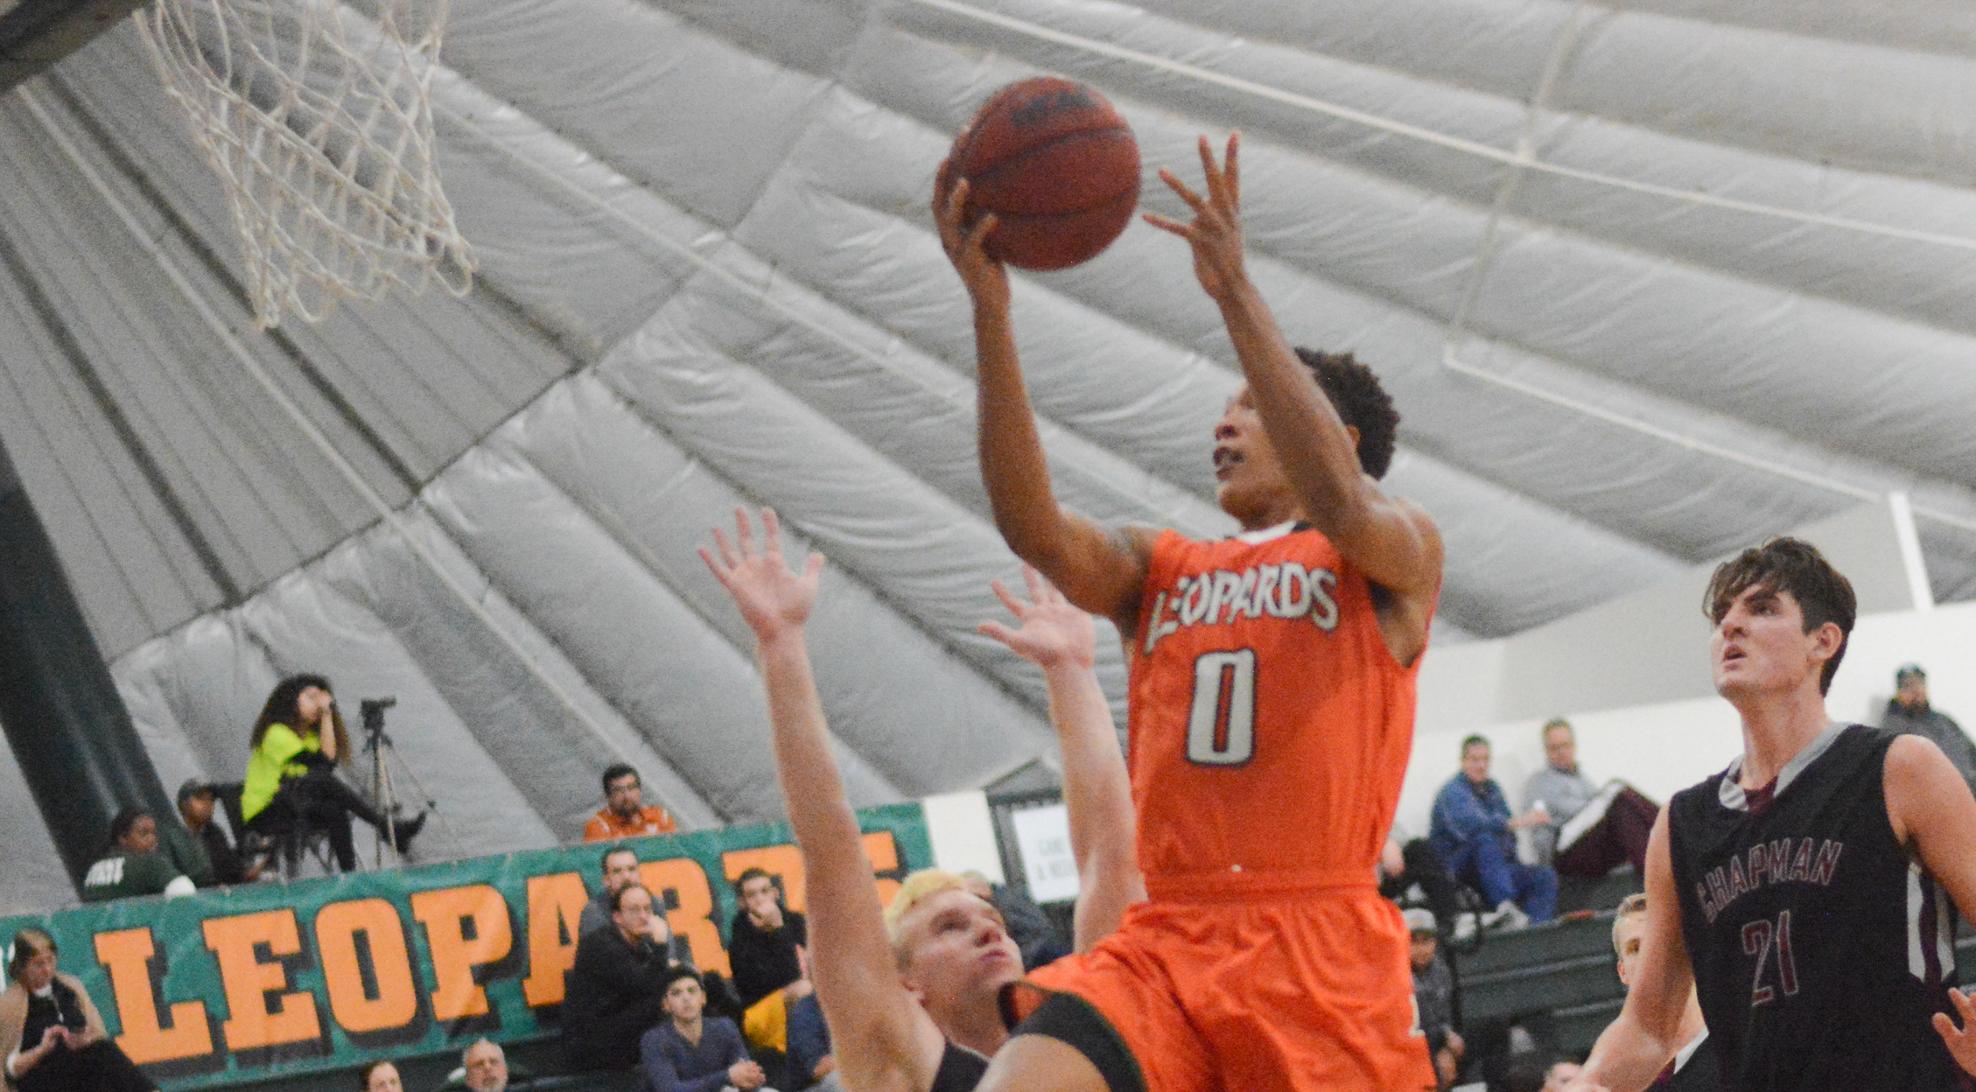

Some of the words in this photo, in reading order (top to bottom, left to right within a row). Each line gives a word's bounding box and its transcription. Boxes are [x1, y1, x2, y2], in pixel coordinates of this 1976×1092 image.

[1186, 649, 1256, 767] 0
[1697, 837, 1843, 924] CHAPMAN
[94, 831, 902, 1066] LEOPAR
[1741, 909, 1799, 1007] 21
